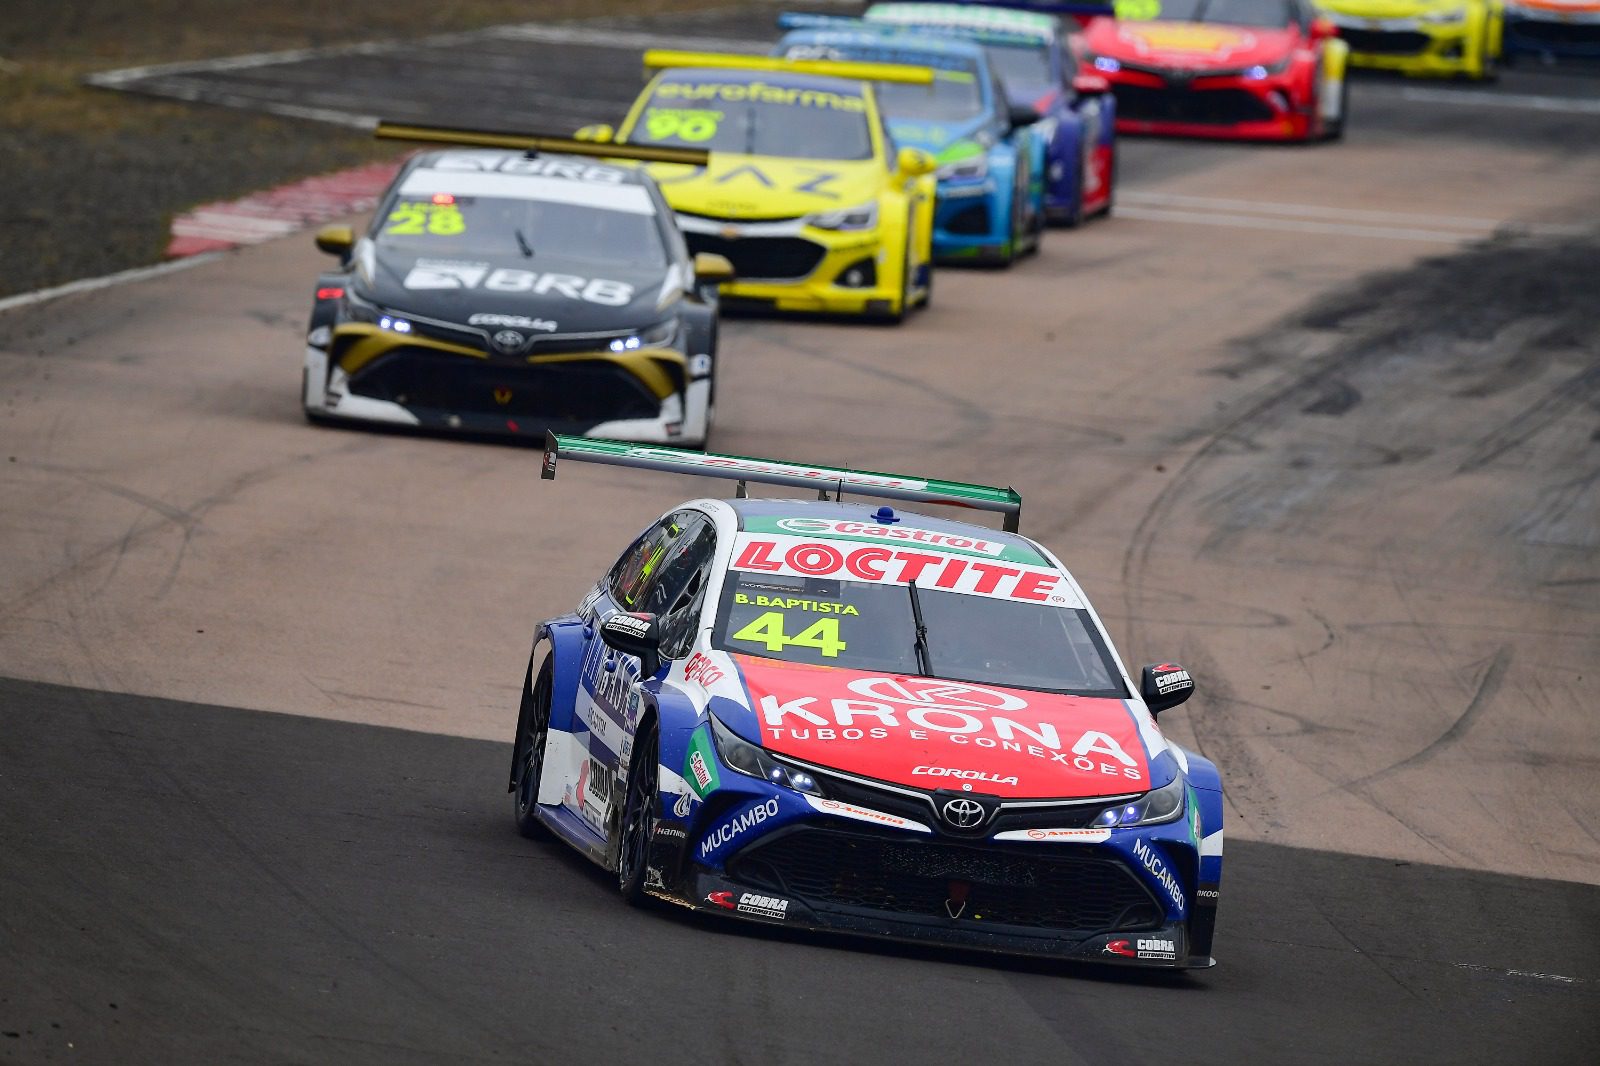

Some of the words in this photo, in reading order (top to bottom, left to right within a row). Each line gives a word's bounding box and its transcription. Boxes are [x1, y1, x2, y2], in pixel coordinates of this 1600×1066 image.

[656, 82, 865, 112] eurofarma
[647, 114, 717, 142] 90
[500, 157, 624, 185] BRB
[387, 209, 466, 236] 28
[485, 268, 634, 306] BRB
[834, 521, 988, 553] Castrol
[734, 541, 1061, 601] LOCTITE
[735, 593, 859, 616] B.BAPTISTA
[606, 623, 646, 638] AUTOMOTIVA
[608, 615, 651, 632] COBRA
[733, 611, 847, 657] 44
[1155, 670, 1190, 688] COBRA
[760, 695, 1138, 767] KRONA
[766, 727, 888, 740] TUBOS
[910, 729, 928, 741] E
[949, 734, 1142, 780] CONEXÕES
[911, 766, 1018, 786] COROLLA
[701, 797, 780, 857] MUCAMBO
[1133, 838, 1184, 911] MUCAMBO
[737, 904, 786, 919] AUTOMOTIVA
[739, 892, 789, 911] COBRA
[1137, 939, 1175, 951] COBRA
